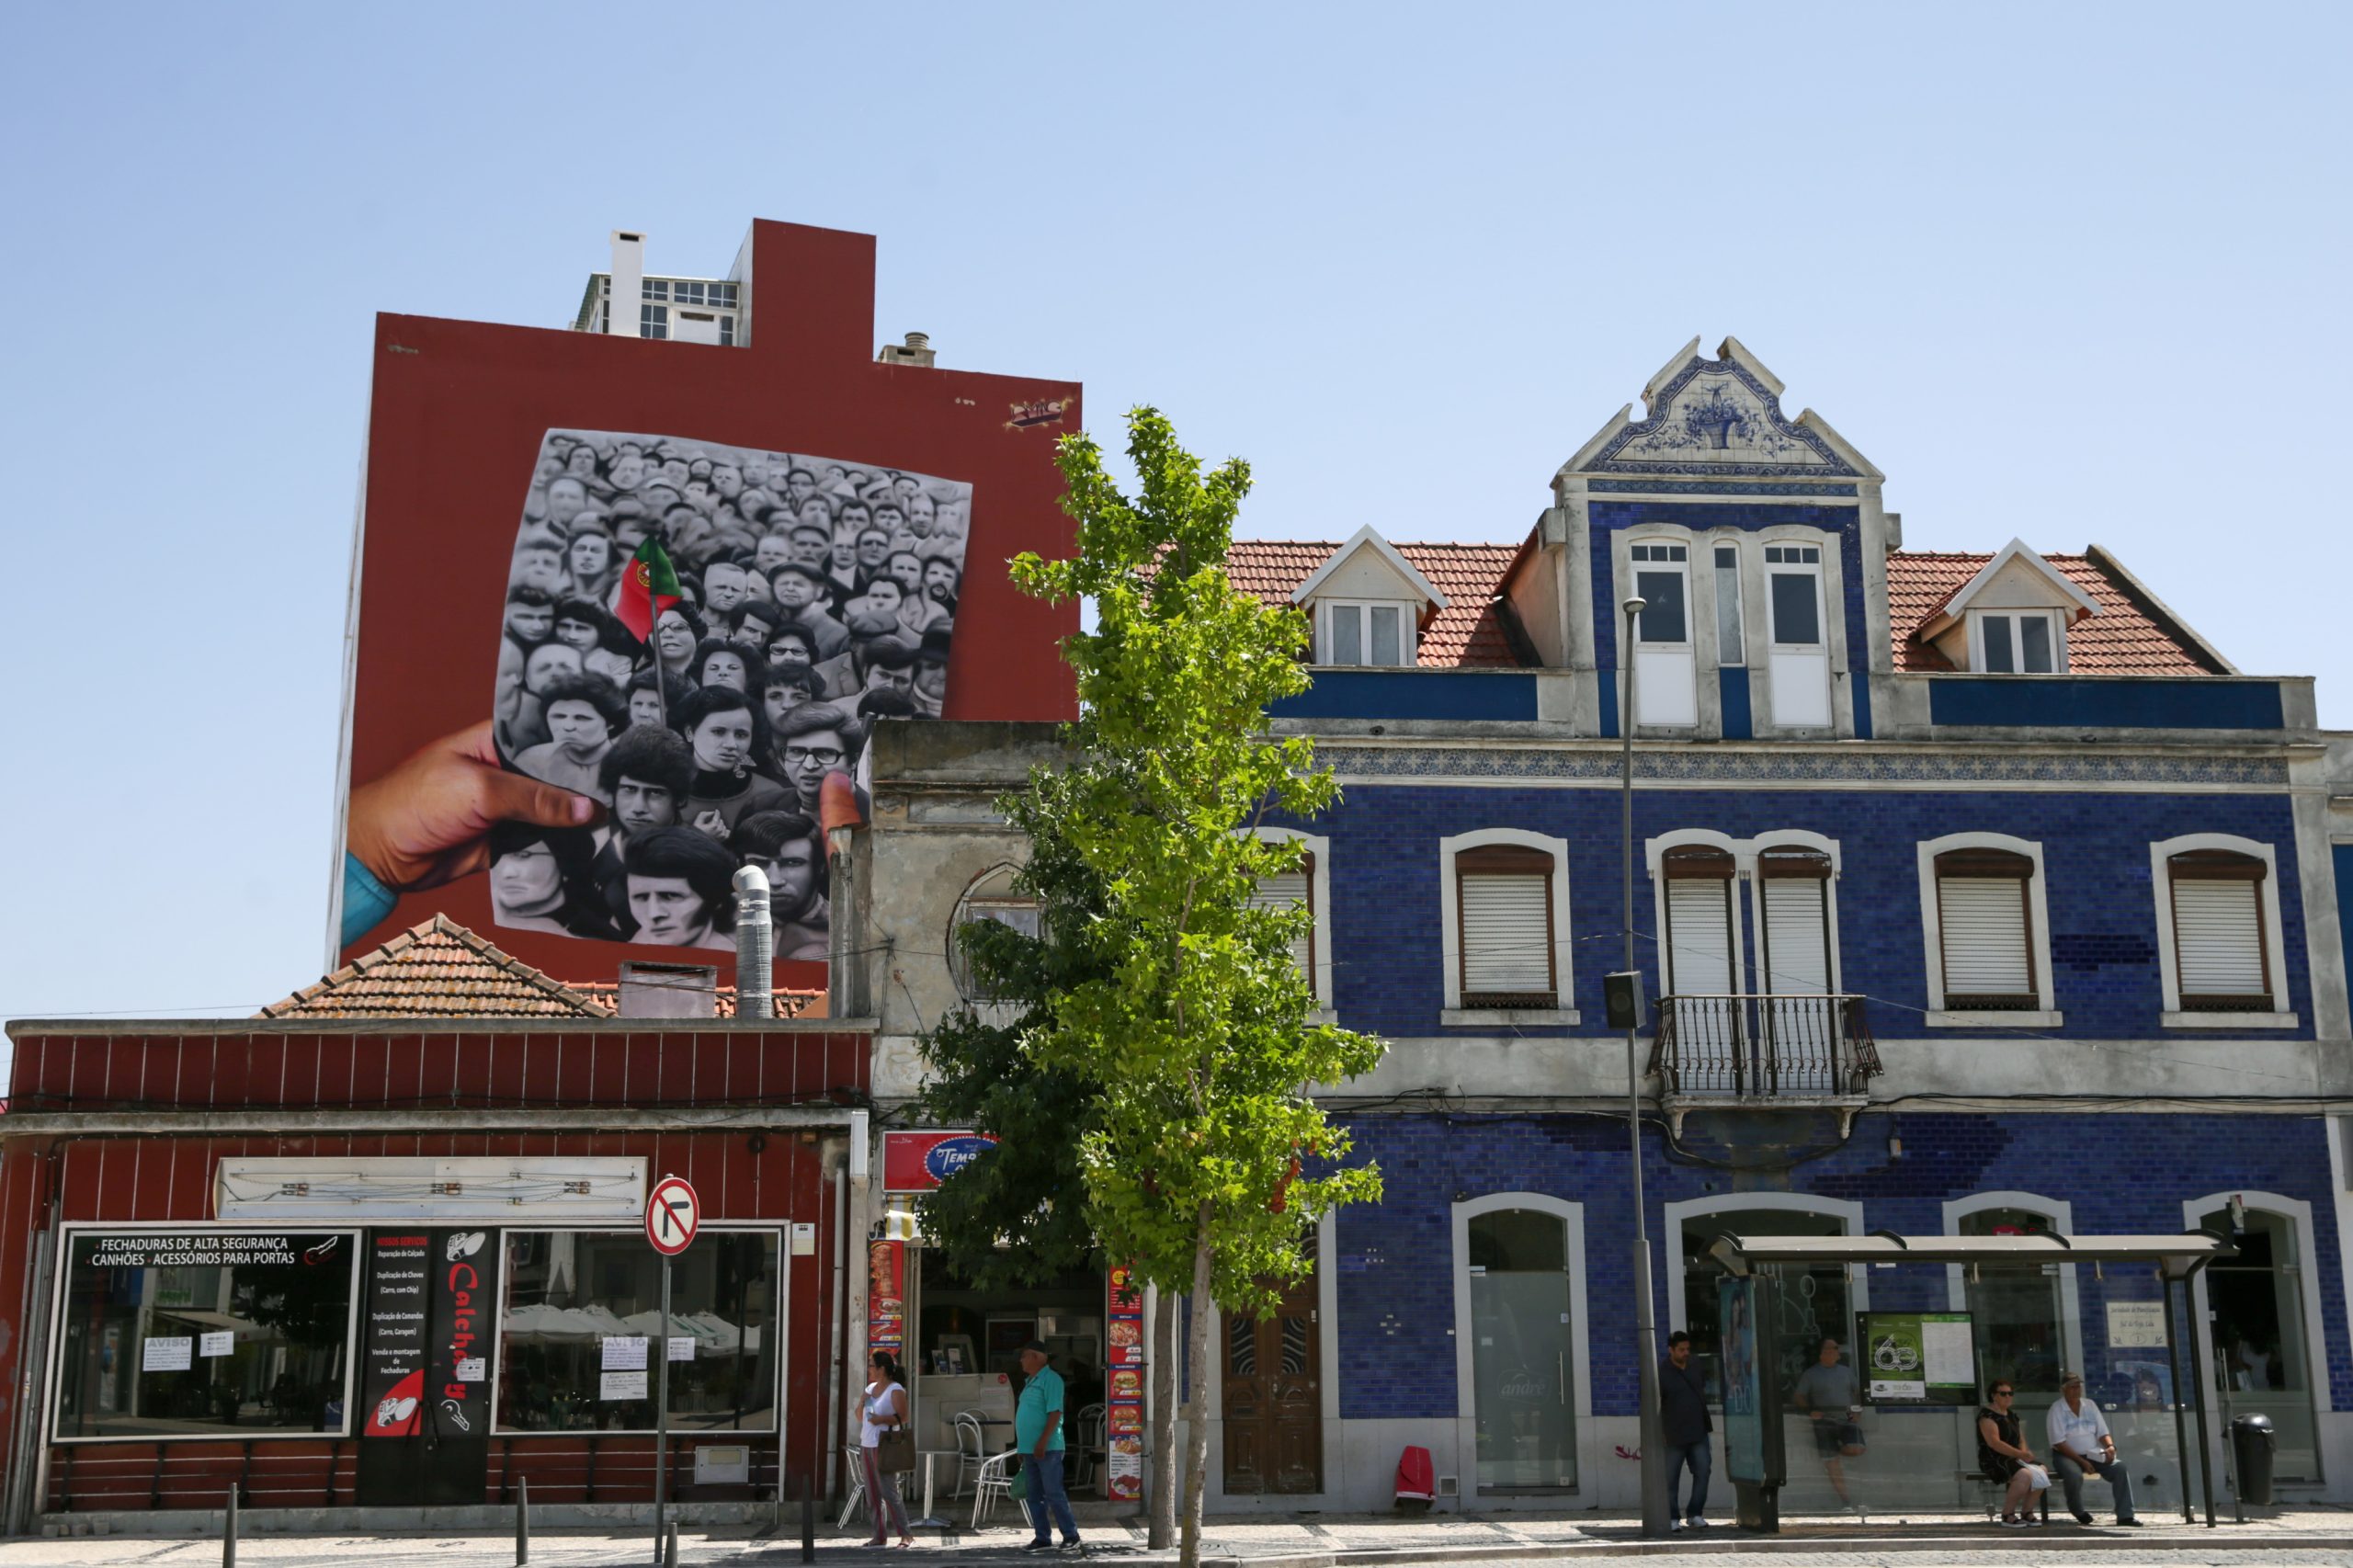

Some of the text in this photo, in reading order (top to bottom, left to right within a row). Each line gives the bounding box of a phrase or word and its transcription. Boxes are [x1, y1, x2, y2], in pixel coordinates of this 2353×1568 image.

[101, 1237, 289, 1252] FECHADURAS DE ALTA SEGURANÇA
[92, 1250, 295, 1266] CANHÕES ACESSÓRIOS PARA PORTAS
[377, 1271, 401, 1279] Duplicação
[372, 1312, 395, 1321] Duplicação
[395, 1312, 402, 1320] de
[147, 1337, 190, 1347] AVISO
[604, 1337, 646, 1347] AVISO
[371, 1347, 388, 1356] Venda
[392, 1348, 421, 1357] montagem
